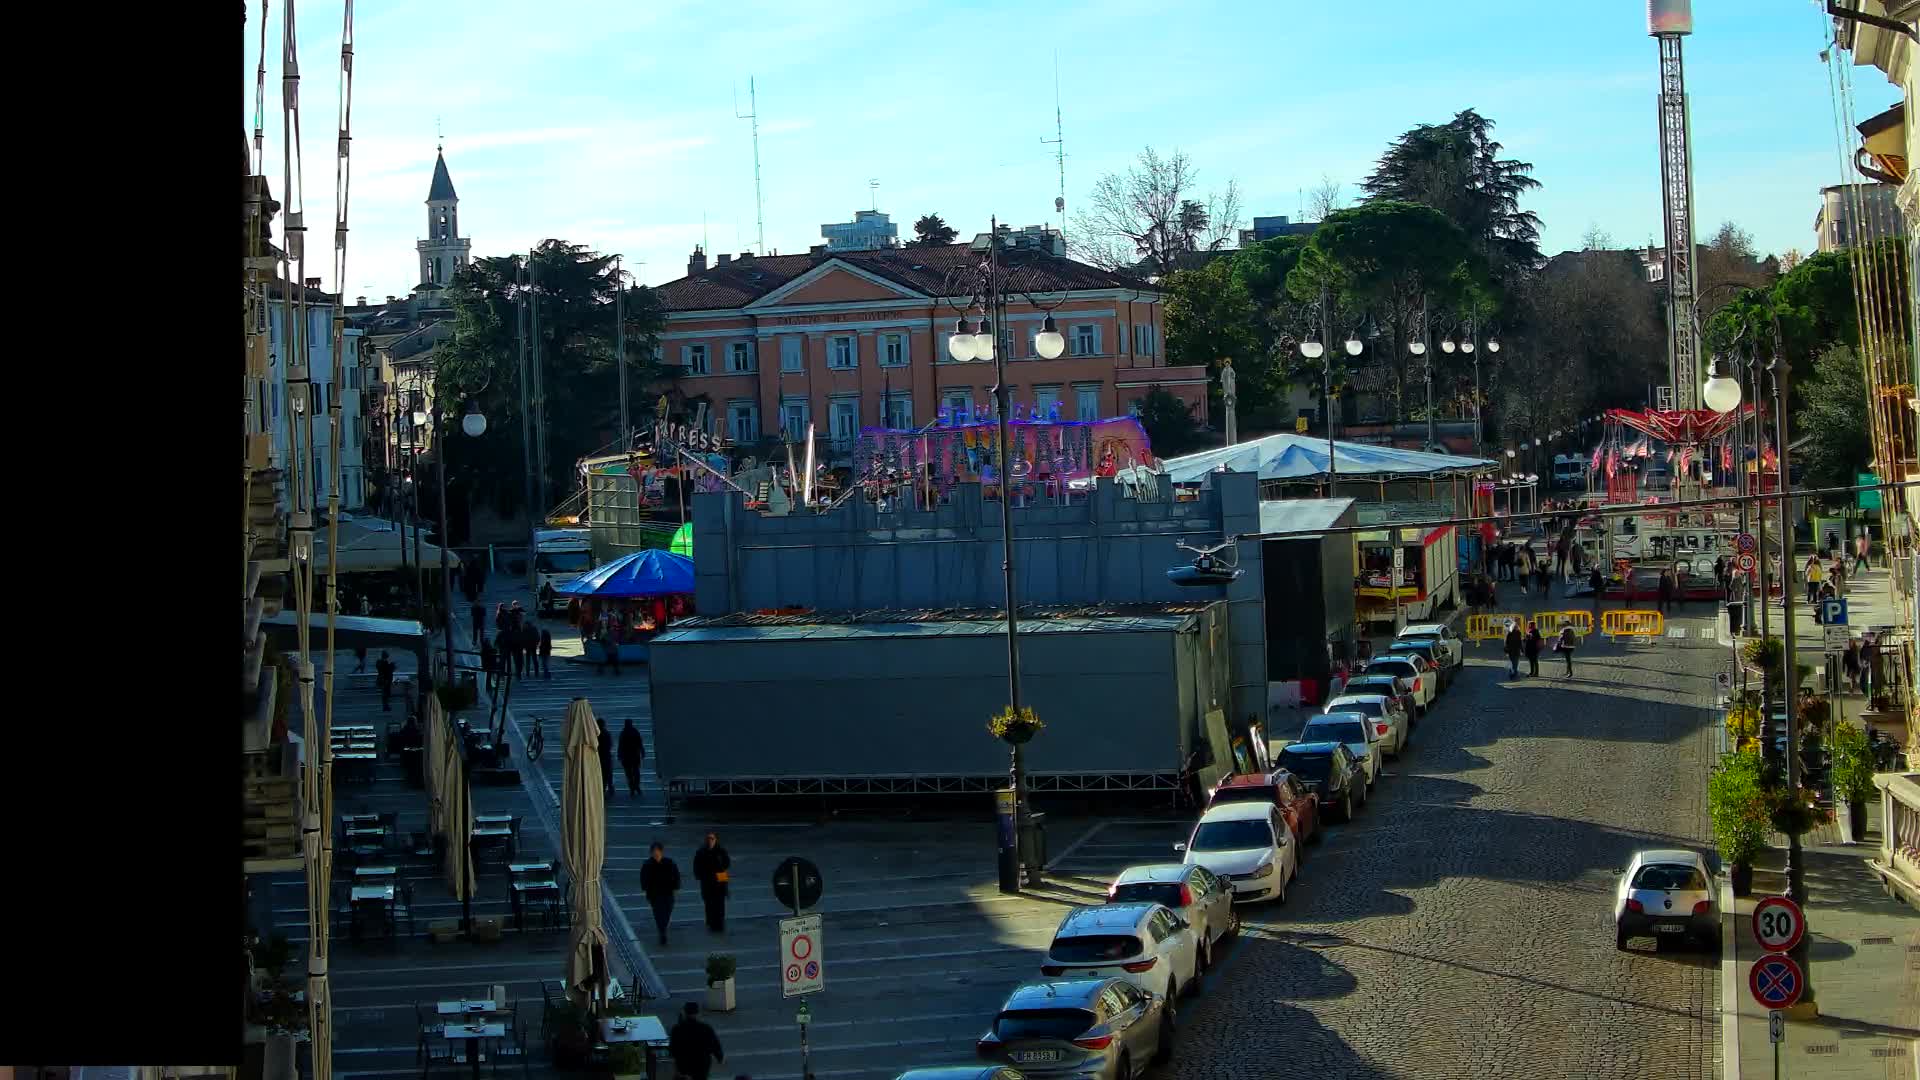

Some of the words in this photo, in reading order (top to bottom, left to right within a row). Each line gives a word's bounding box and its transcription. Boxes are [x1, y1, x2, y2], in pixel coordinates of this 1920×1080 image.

[1742, 558, 1751, 567] 20
[1827, 602, 1842, 622] P
[1762, 912, 1791, 938] 30
[789, 969, 798, 978] 20
